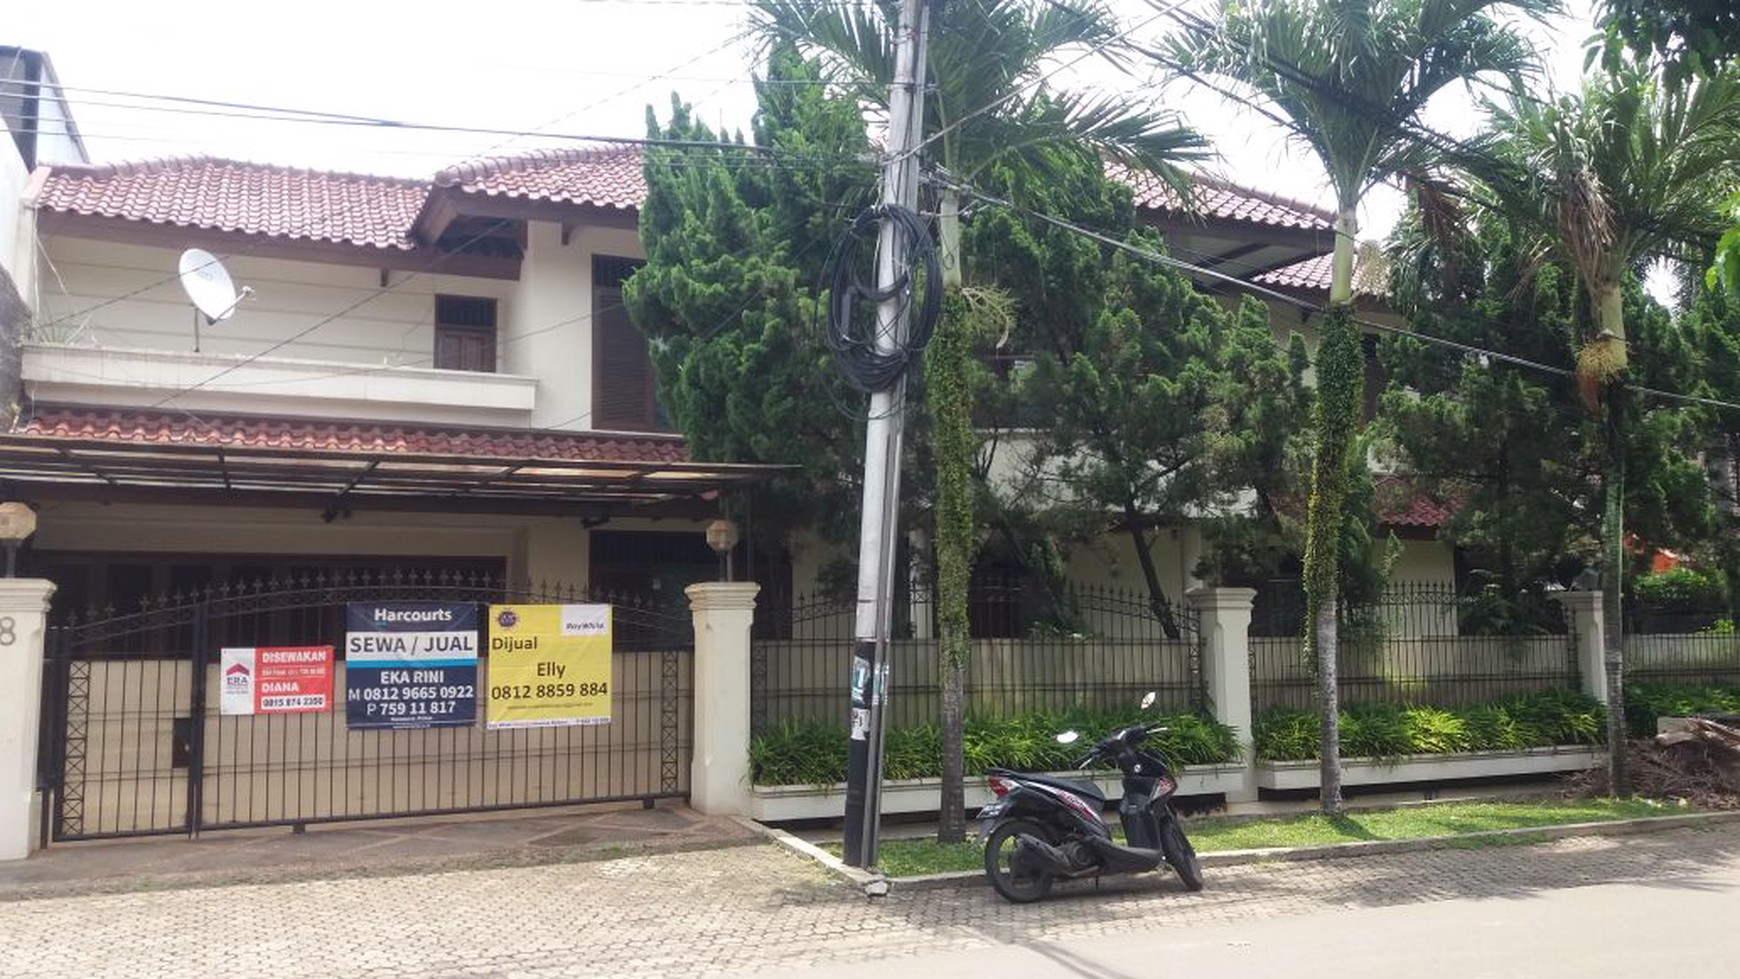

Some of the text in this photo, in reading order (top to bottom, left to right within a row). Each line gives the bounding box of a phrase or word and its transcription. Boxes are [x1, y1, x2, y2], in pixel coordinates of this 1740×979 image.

[374, 608, 452, 621] Harcourts
[0, 616, 16, 646] 8
[350, 636, 473, 656] SEWA / JUAL
[492, 636, 538, 653] Dijual
[262, 651, 327, 663] DISEWAKAN
[380, 670, 444, 684] EKA RINI
[537, 661, 566, 679] Elly
[226, 677, 248, 686] ERA
[261, 682, 299, 693] DIANA
[348, 685, 474, 701] M 0812 9665 0922
[491, 682, 608, 700] 0812 8859 884
[367, 701, 456, 715] P 759 11 817
